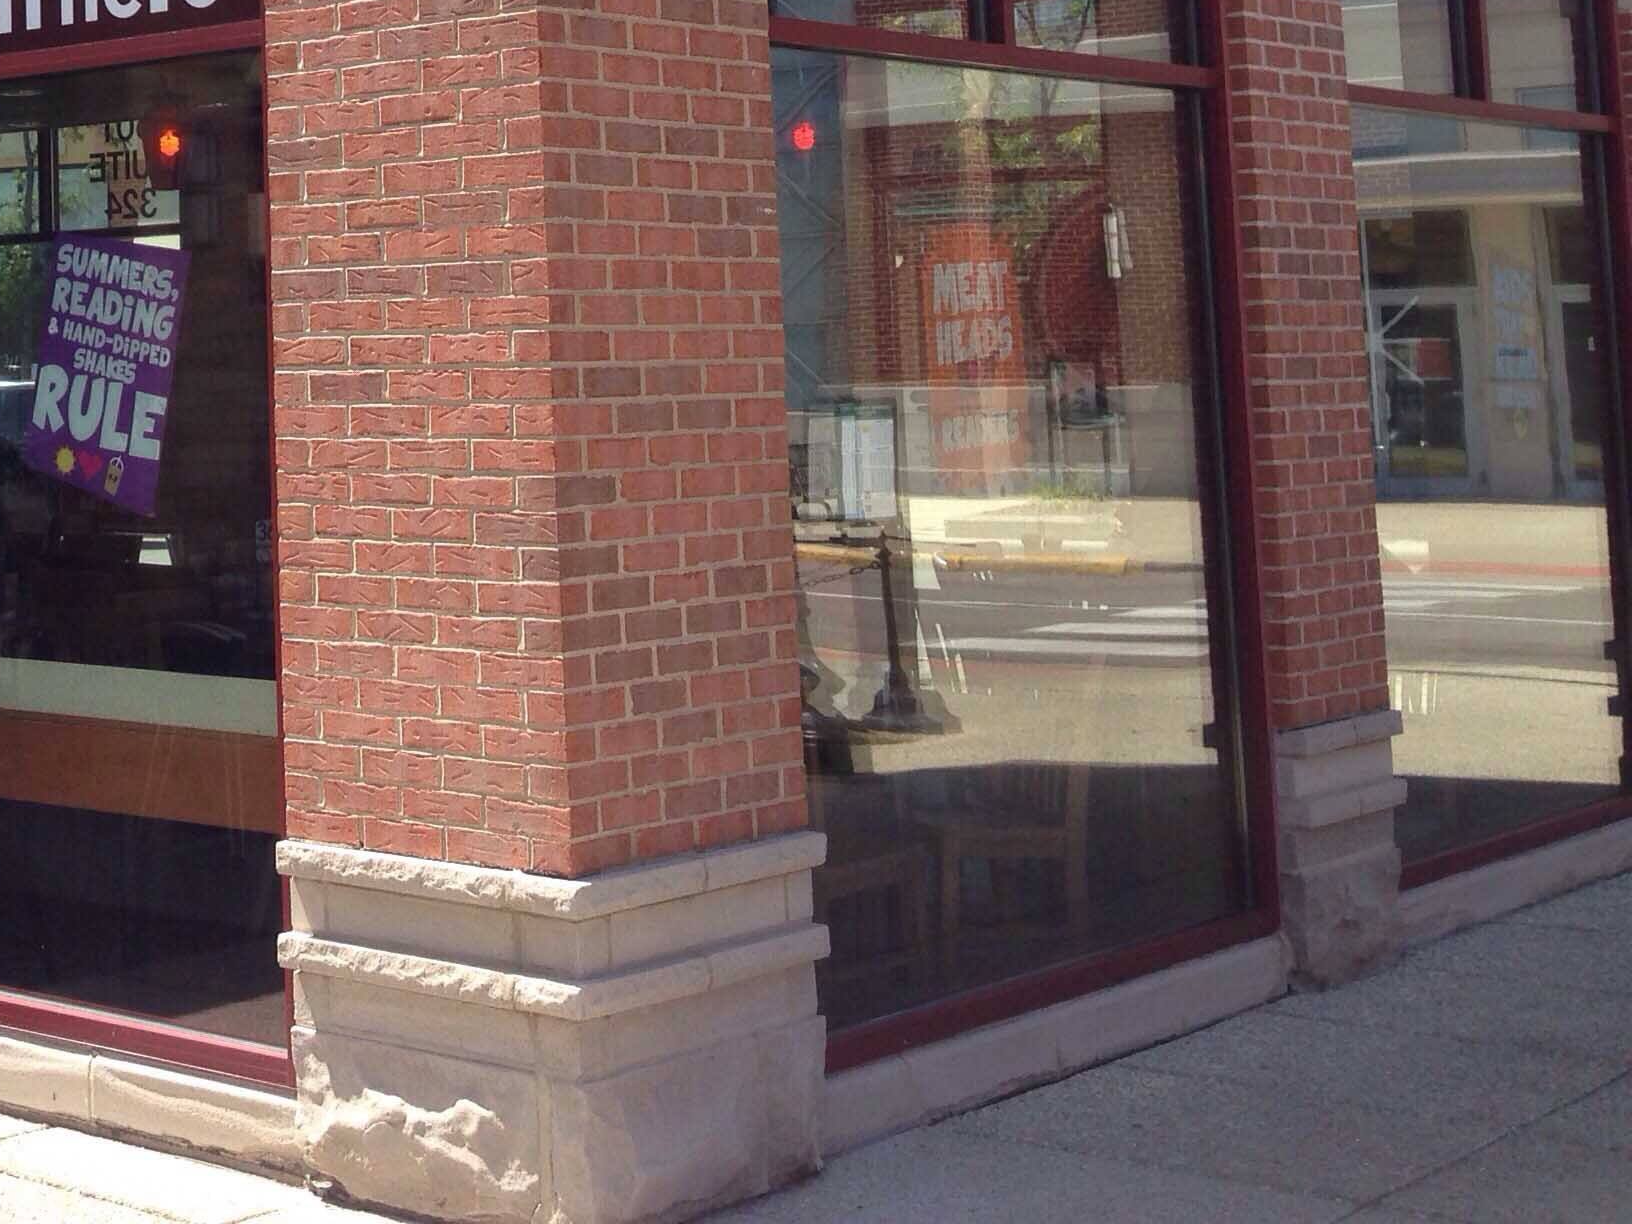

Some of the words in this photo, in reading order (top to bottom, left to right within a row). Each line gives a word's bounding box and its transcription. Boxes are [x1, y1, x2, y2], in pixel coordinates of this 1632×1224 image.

[56, 243, 180, 302] SUMMERS,
[932, 260, 1008, 315] MEAT
[47, 316, 59, 335] &
[935, 314, 1013, 367] HEADS
[72, 347, 137, 385] SHAKES
[32, 363, 168, 461] RULE
